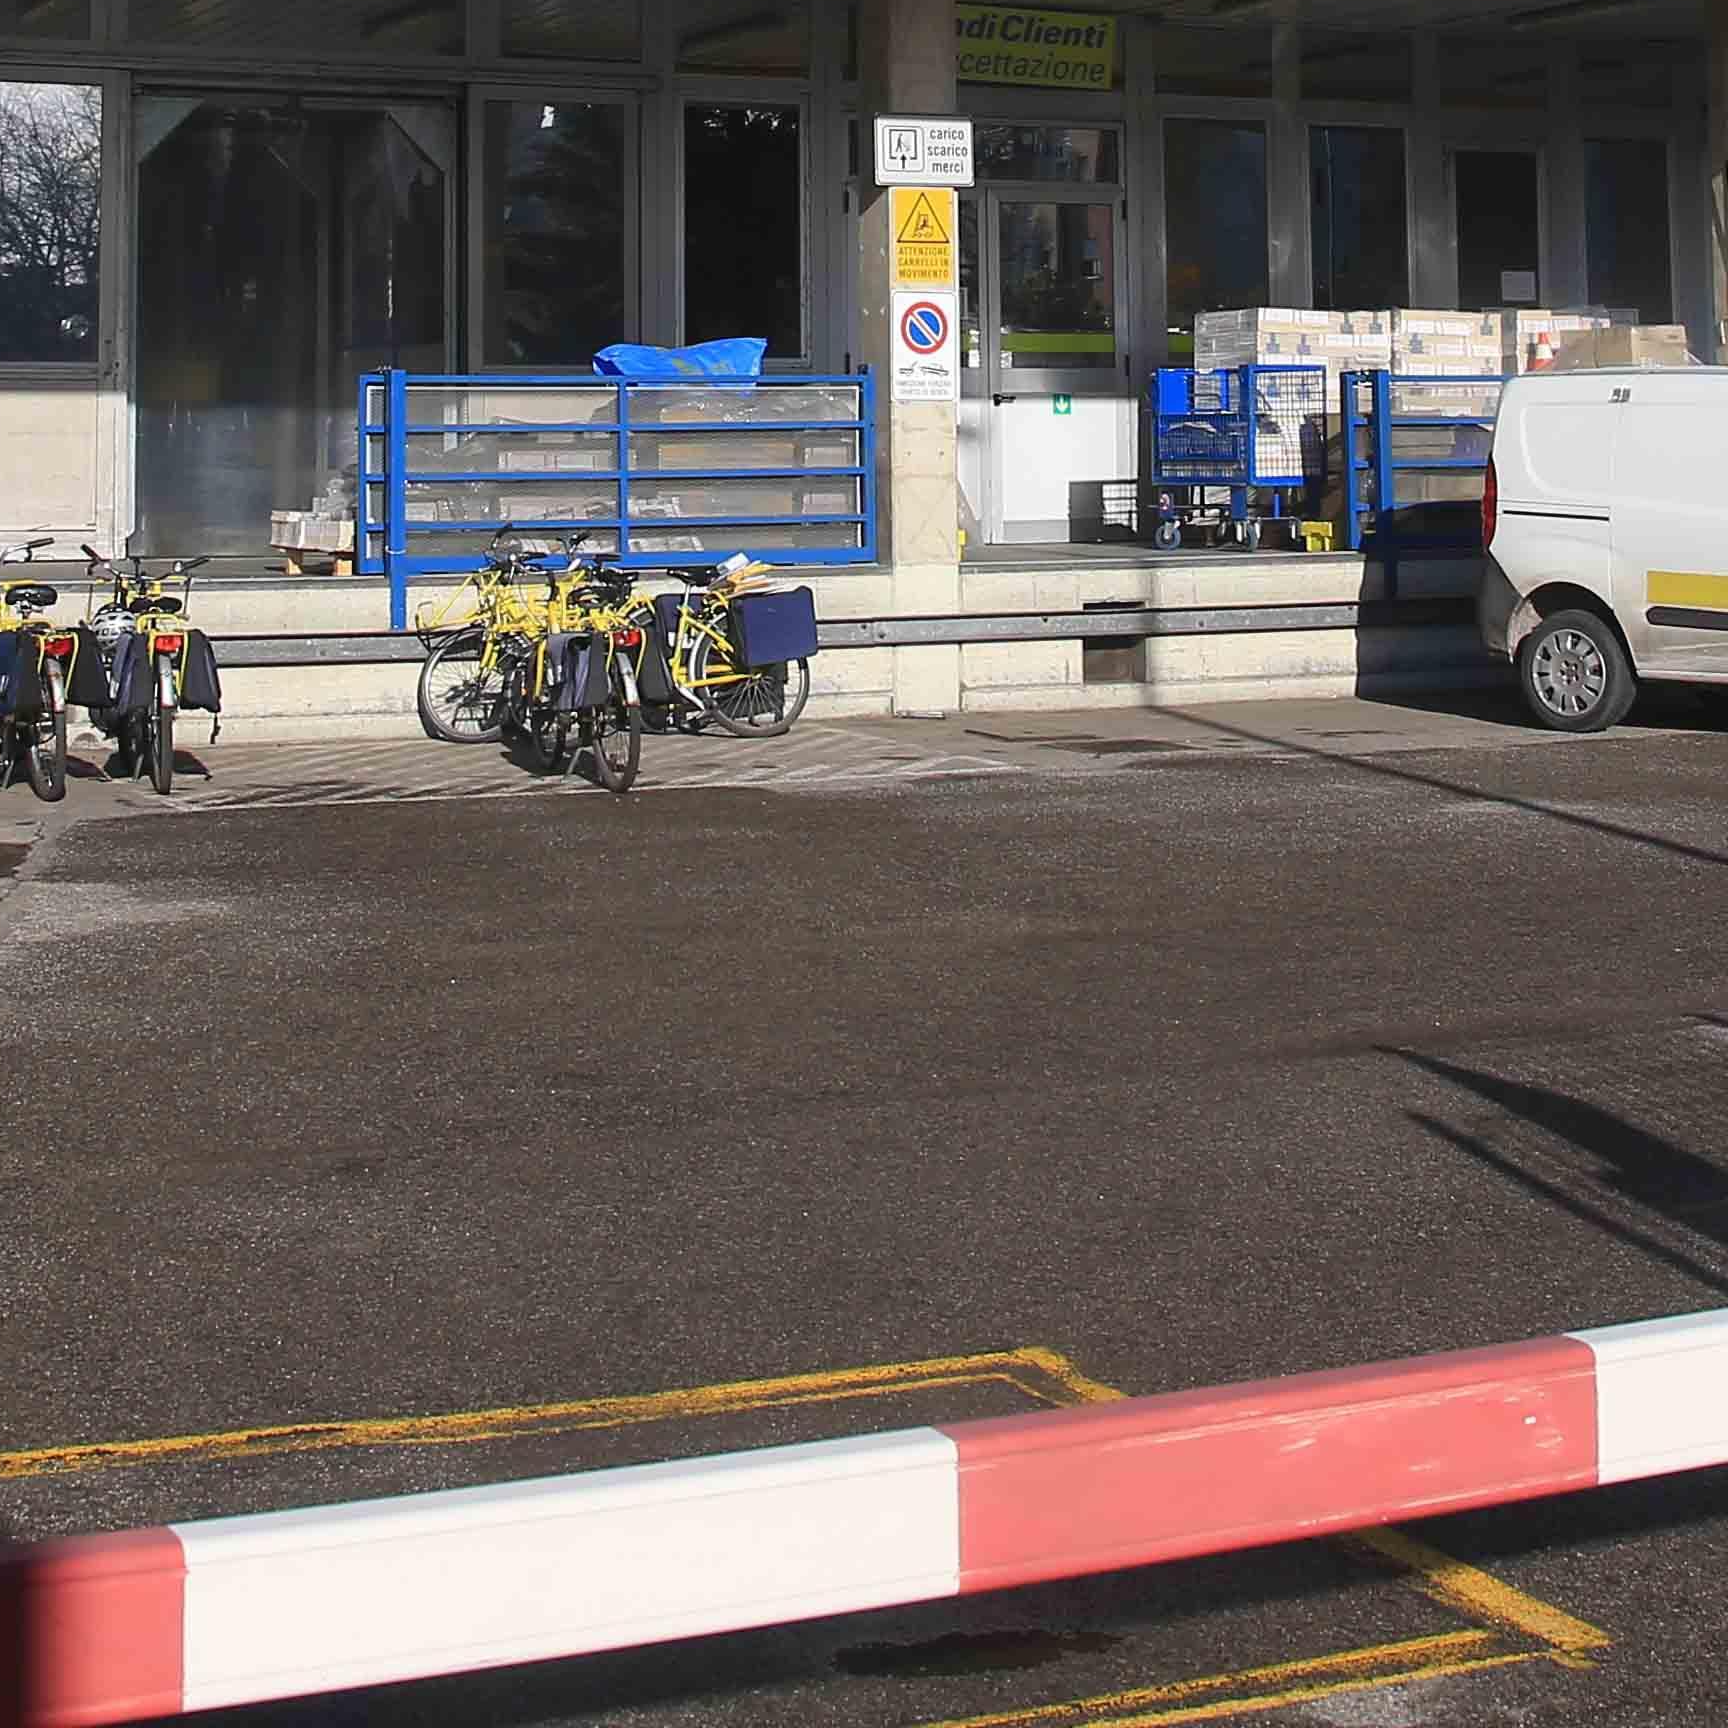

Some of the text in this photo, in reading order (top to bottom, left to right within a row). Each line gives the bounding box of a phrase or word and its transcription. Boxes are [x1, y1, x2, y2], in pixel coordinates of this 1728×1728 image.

[1001, 15, 1107, 49] Clienti
[956, 51, 1106, 83] cettazione
[929, 128, 965, 141] carico
[927, 145, 968, 158] scarico
[931, 161, 964, 174] merci
[898, 247, 950, 257] ATTENZIONE
[898, 268, 949, 279] MOVIMENTO
